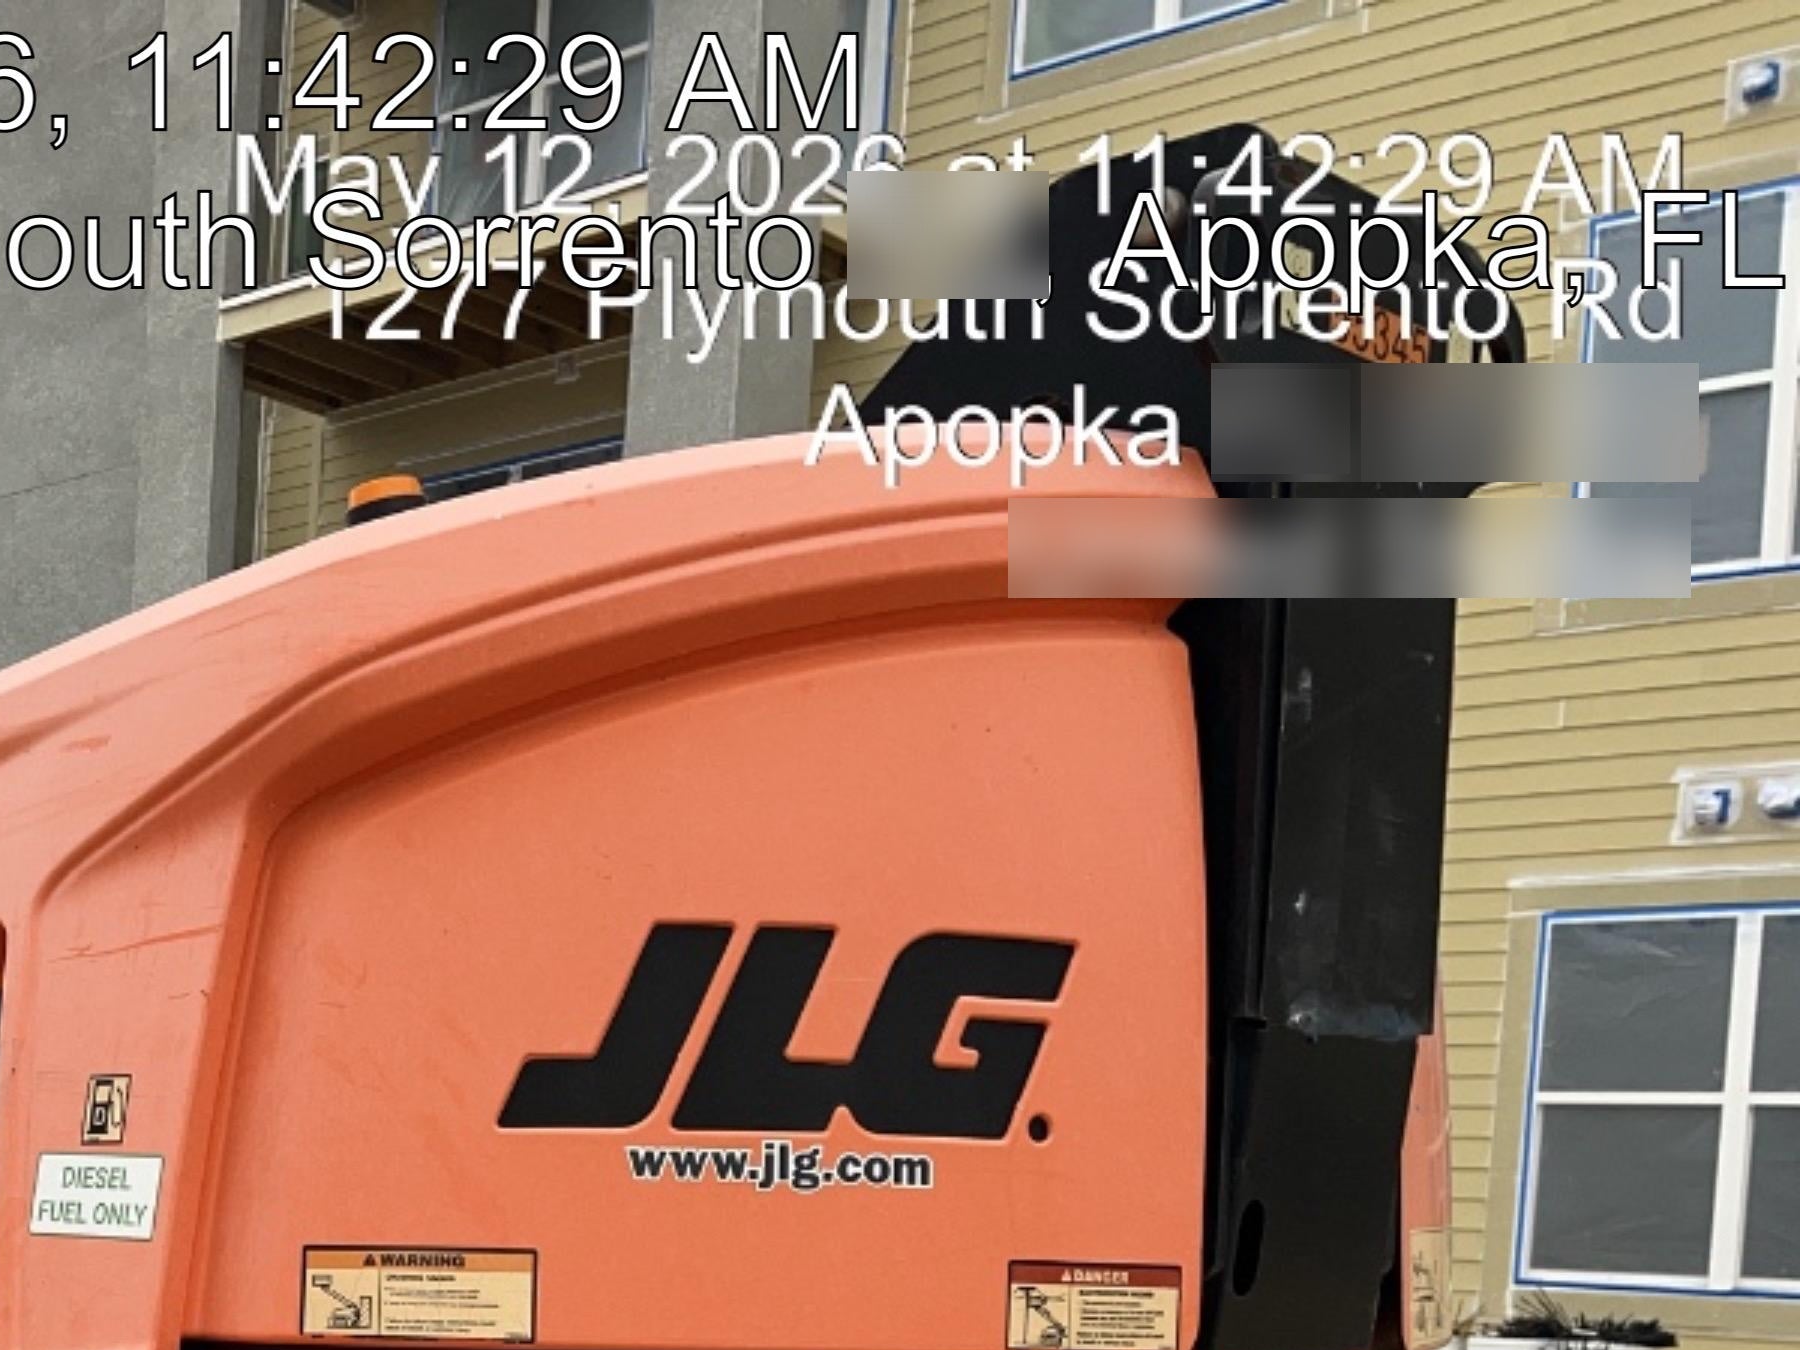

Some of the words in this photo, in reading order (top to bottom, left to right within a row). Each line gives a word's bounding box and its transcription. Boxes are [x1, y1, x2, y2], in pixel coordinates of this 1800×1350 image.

[497, 921, 1077, 1141] JLG
[61, 1165, 132, 1190] DIESEL
[627, 1141, 933, 1190] www.jlg.com
[37, 1199, 87, 1224] FUEL
[93, 1202, 147, 1226] ONLY
[379, 1252, 466, 1268] WARNING
[1073, 1268, 1130, 1284] DANGER
